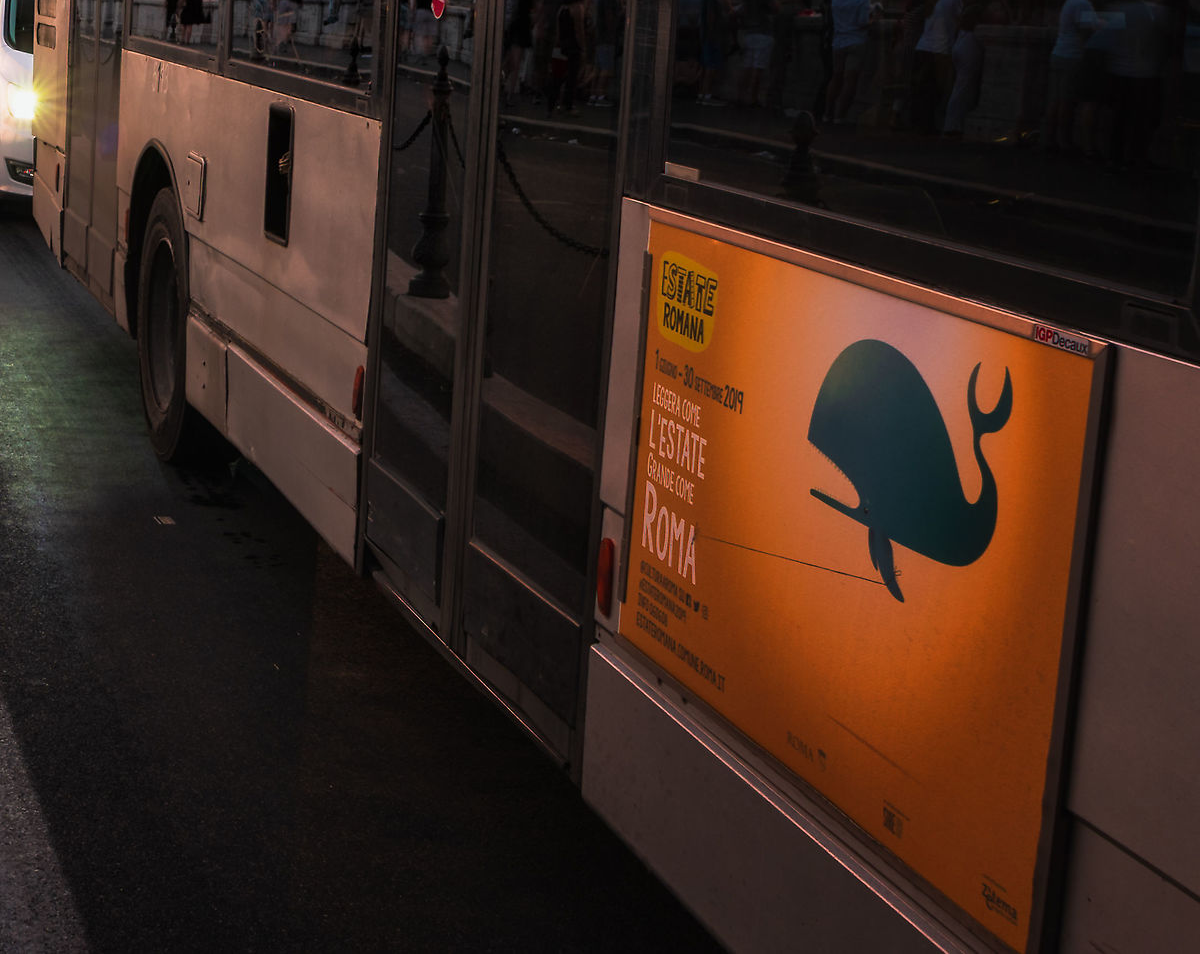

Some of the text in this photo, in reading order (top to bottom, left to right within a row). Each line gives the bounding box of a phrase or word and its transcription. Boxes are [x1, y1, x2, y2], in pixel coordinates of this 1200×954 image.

[661, 260, 718, 317] ESTATE
[663, 302, 704, 344] ROMANA
[1035, 326, 1088, 354] IGPDecaux
[652, 382, 701, 428] LEGGERA COME
[655, 349, 660, 370] 1
[683, 364, 694, 389] 30
[694, 376, 724, 404] SETTEMBRE
[723, 384, 744, 415] 2019
[649, 409, 707, 480] L'ESTATE
[647, 452, 695, 506] GRANDE COME
[641, 480, 696, 586] ROMA
